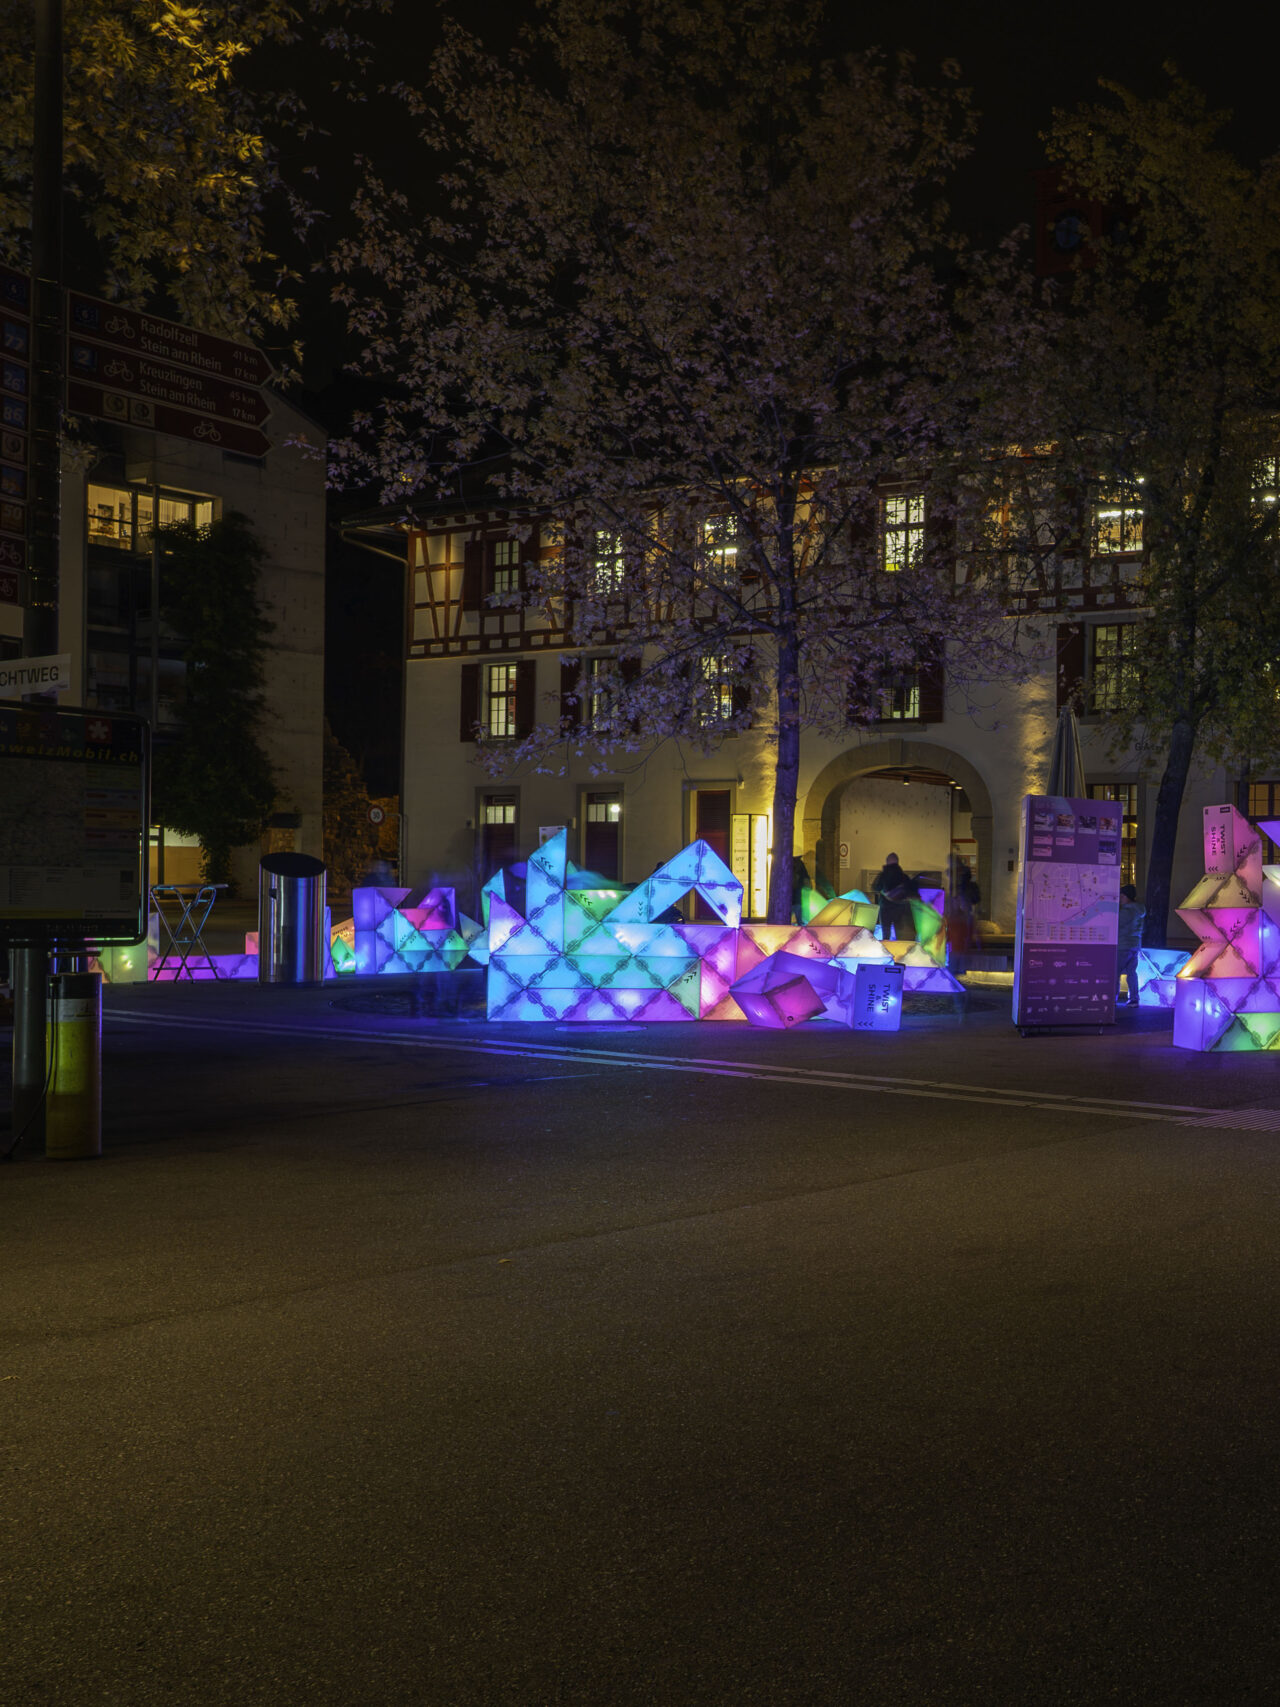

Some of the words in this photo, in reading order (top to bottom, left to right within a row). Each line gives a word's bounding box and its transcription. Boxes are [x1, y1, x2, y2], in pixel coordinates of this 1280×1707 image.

[140, 318, 198, 347] Radolfzell
[140, 336, 170, 354] Stein
[171, 347, 190, 364] am
[190, 351, 222, 371] Rhein
[244, 353, 258, 366] km
[4, 371, 24, 390] 26
[139, 360, 203, 391] Kreuzlingen
[243, 369, 258, 382] km
[139, 379, 168, 398] Stein
[168, 389, 187, 404] am
[186, 392, 217, 412] Rhein
[242, 394, 256, 406] km
[3, 406, 23, 424] 86
[241, 410, 256, 423] km
[0, 666, 59, 687] CHTWEG
[866, 984, 876, 1013] SHINE
[881, 984, 890, 1013] TWIST
